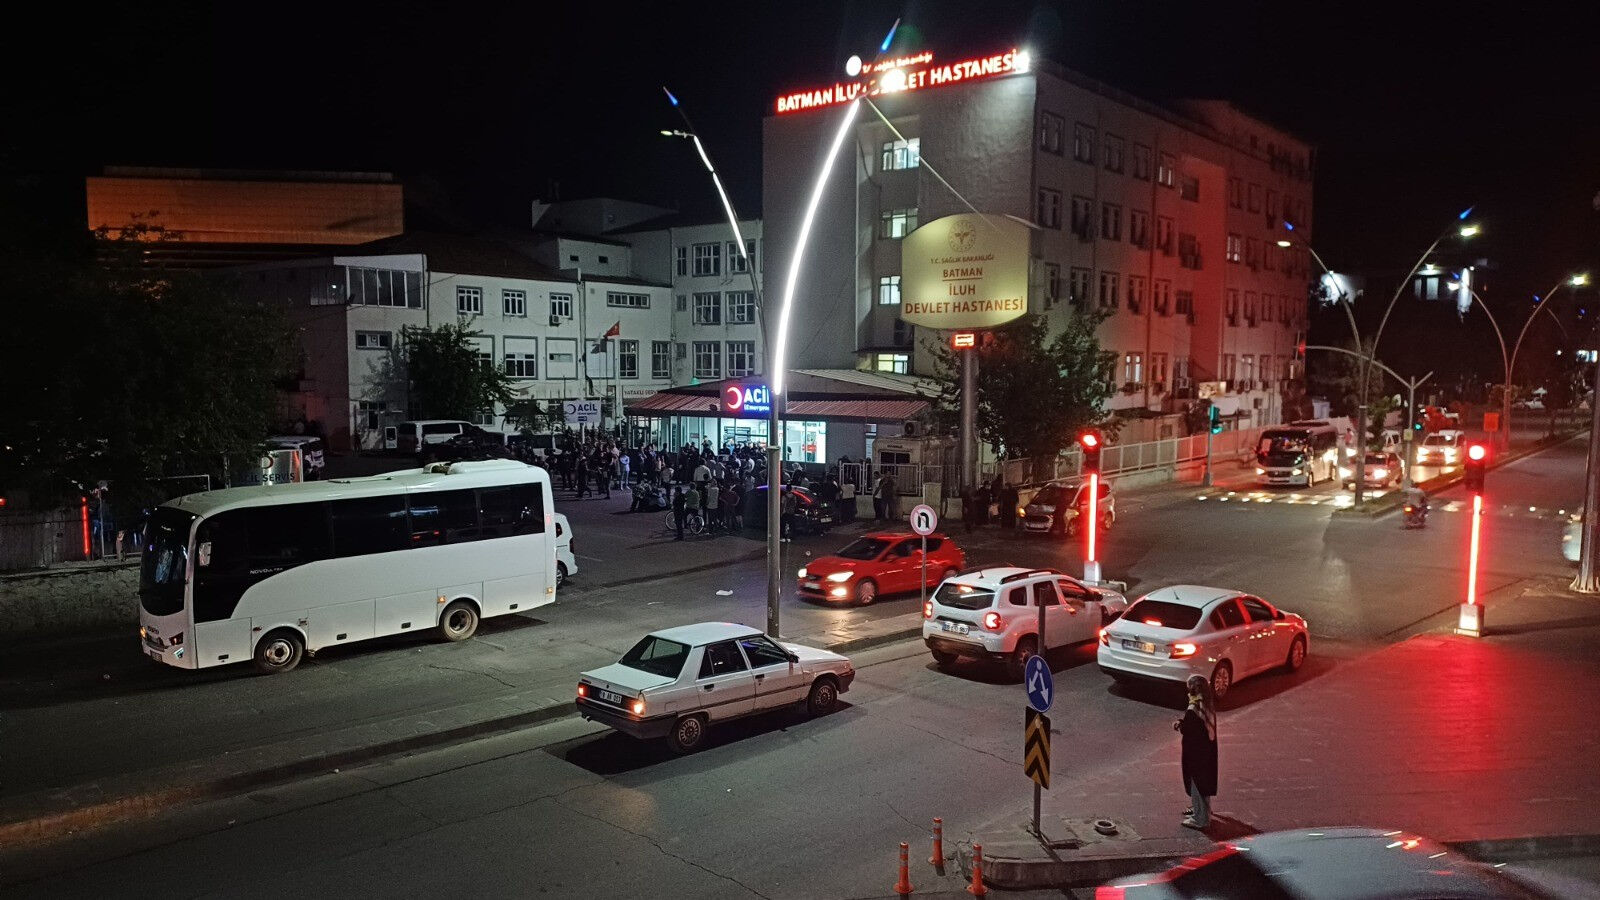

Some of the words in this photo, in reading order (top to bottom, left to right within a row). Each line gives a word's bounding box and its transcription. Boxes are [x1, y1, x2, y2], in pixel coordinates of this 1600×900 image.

[777, 88, 833, 112] BATMAN
[930, 49, 1018, 86] HASTANESİ
[943, 267, 983, 278] BATMAN
[949, 283, 976, 296] İLUH
[905, 302, 950, 314] DEVLET
[952, 296, 1024, 313] HASTANESİ
[578, 402, 598, 412] ACİL
